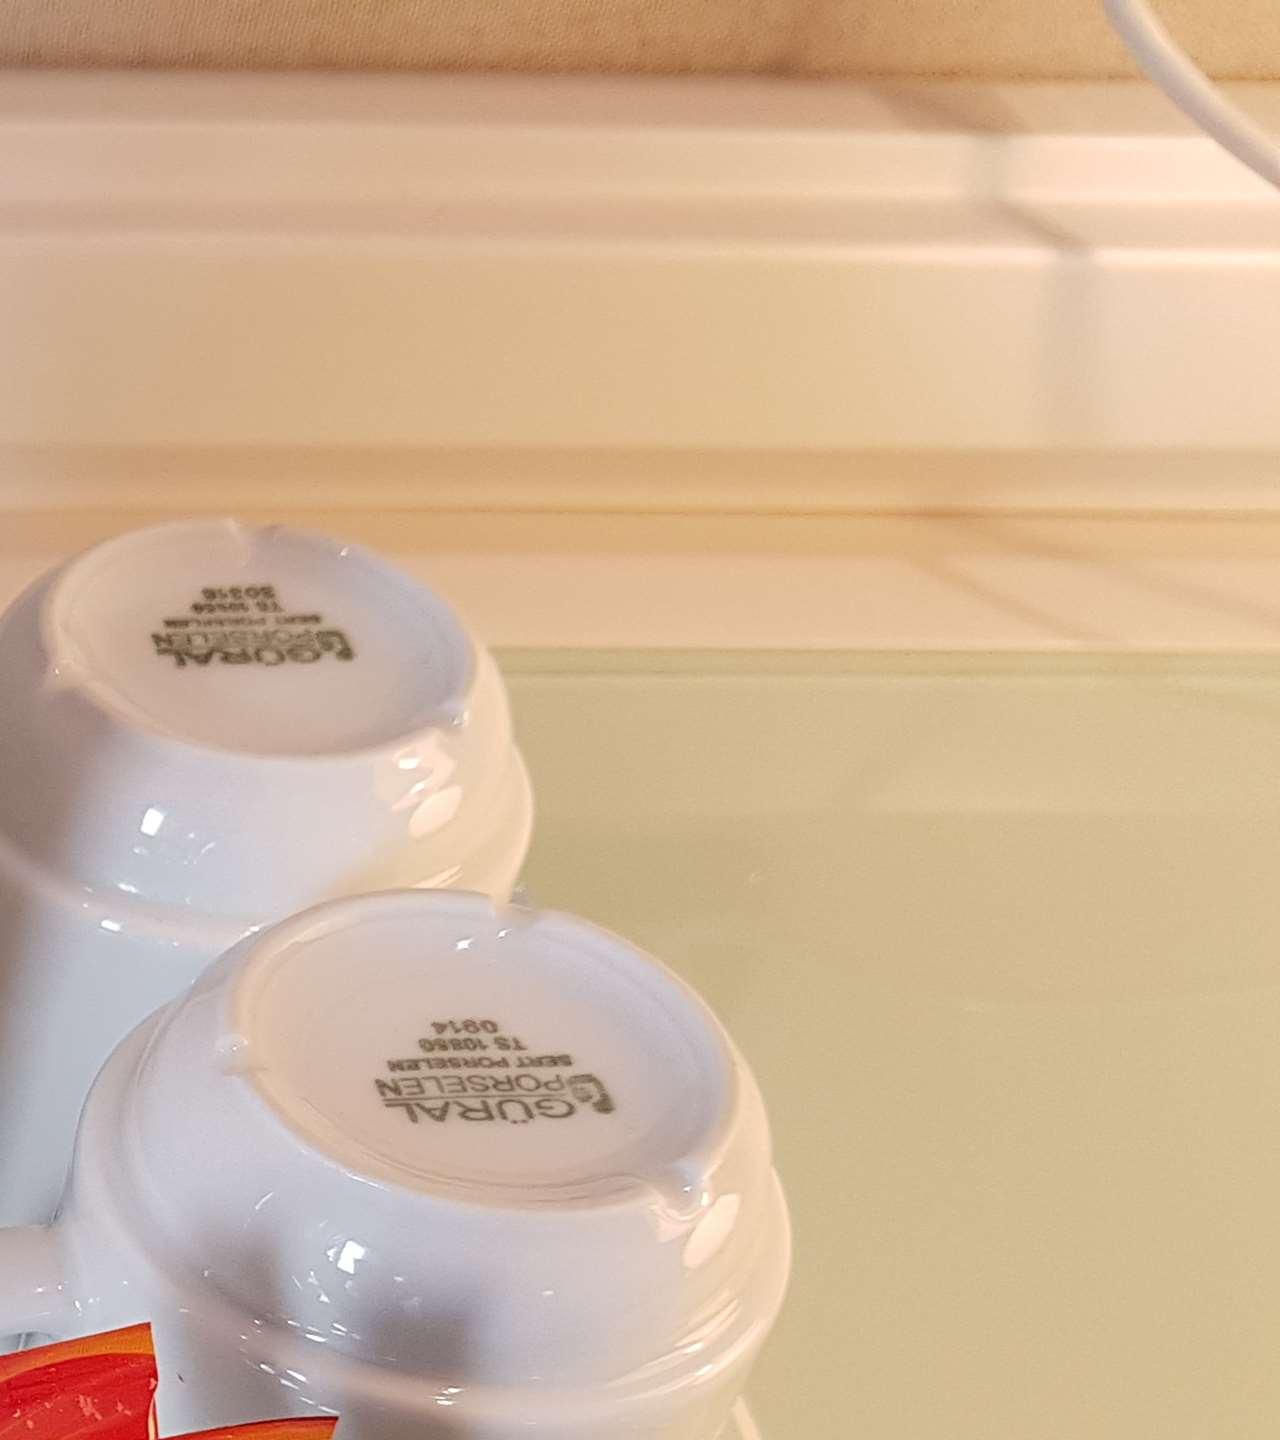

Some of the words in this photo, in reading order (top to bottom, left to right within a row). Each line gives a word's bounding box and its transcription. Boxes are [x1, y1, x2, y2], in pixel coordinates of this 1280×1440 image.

[493, 1036, 527, 1051] TS
[387, 1056, 510, 1073] PORSELEN
[374, 1073, 566, 1098] PORSELEN
[383, 1098, 577, 1124] GÜRAL
